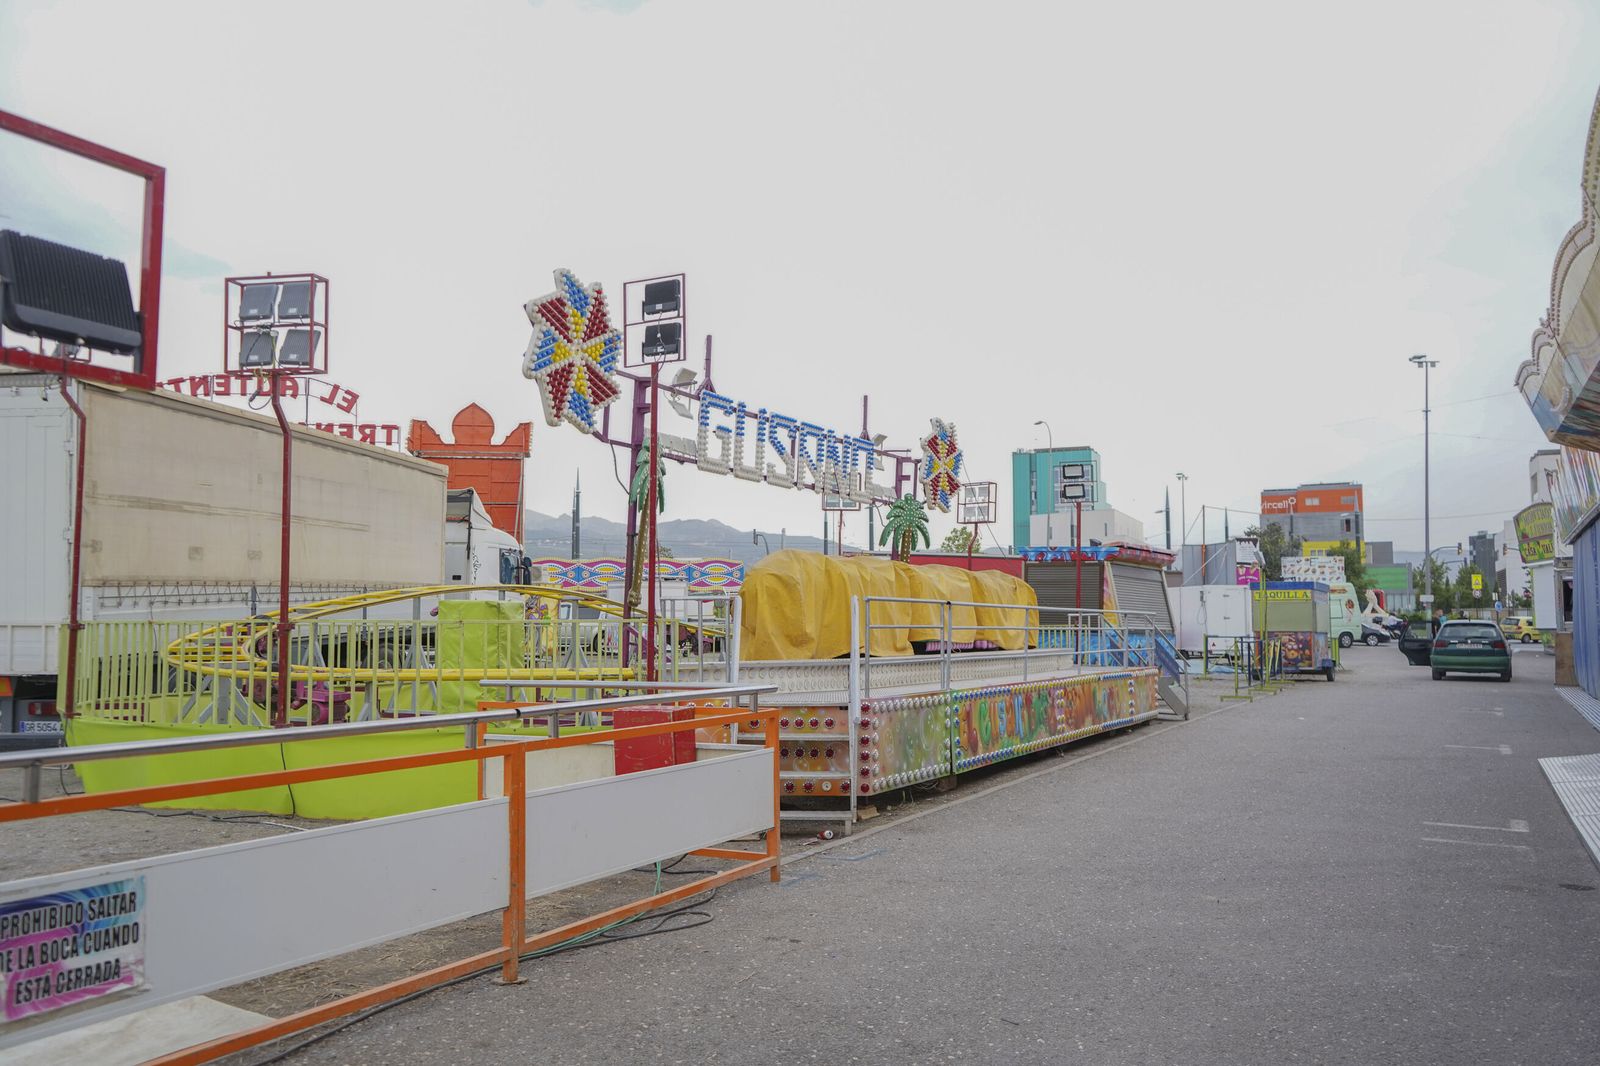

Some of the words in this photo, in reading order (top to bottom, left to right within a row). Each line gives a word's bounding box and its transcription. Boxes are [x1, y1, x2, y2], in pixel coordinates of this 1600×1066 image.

[1256, 591, 1309, 600] TQUILLA
[0, 902, 83, 940] PROHIBIDO
[88, 892, 137, 921] SALTAR
[18, 945, 35, 970] LA
[40, 936, 79, 965] BOCA
[83, 922, 139, 955] CUANDO
[56, 958, 121, 994] CERRADA
